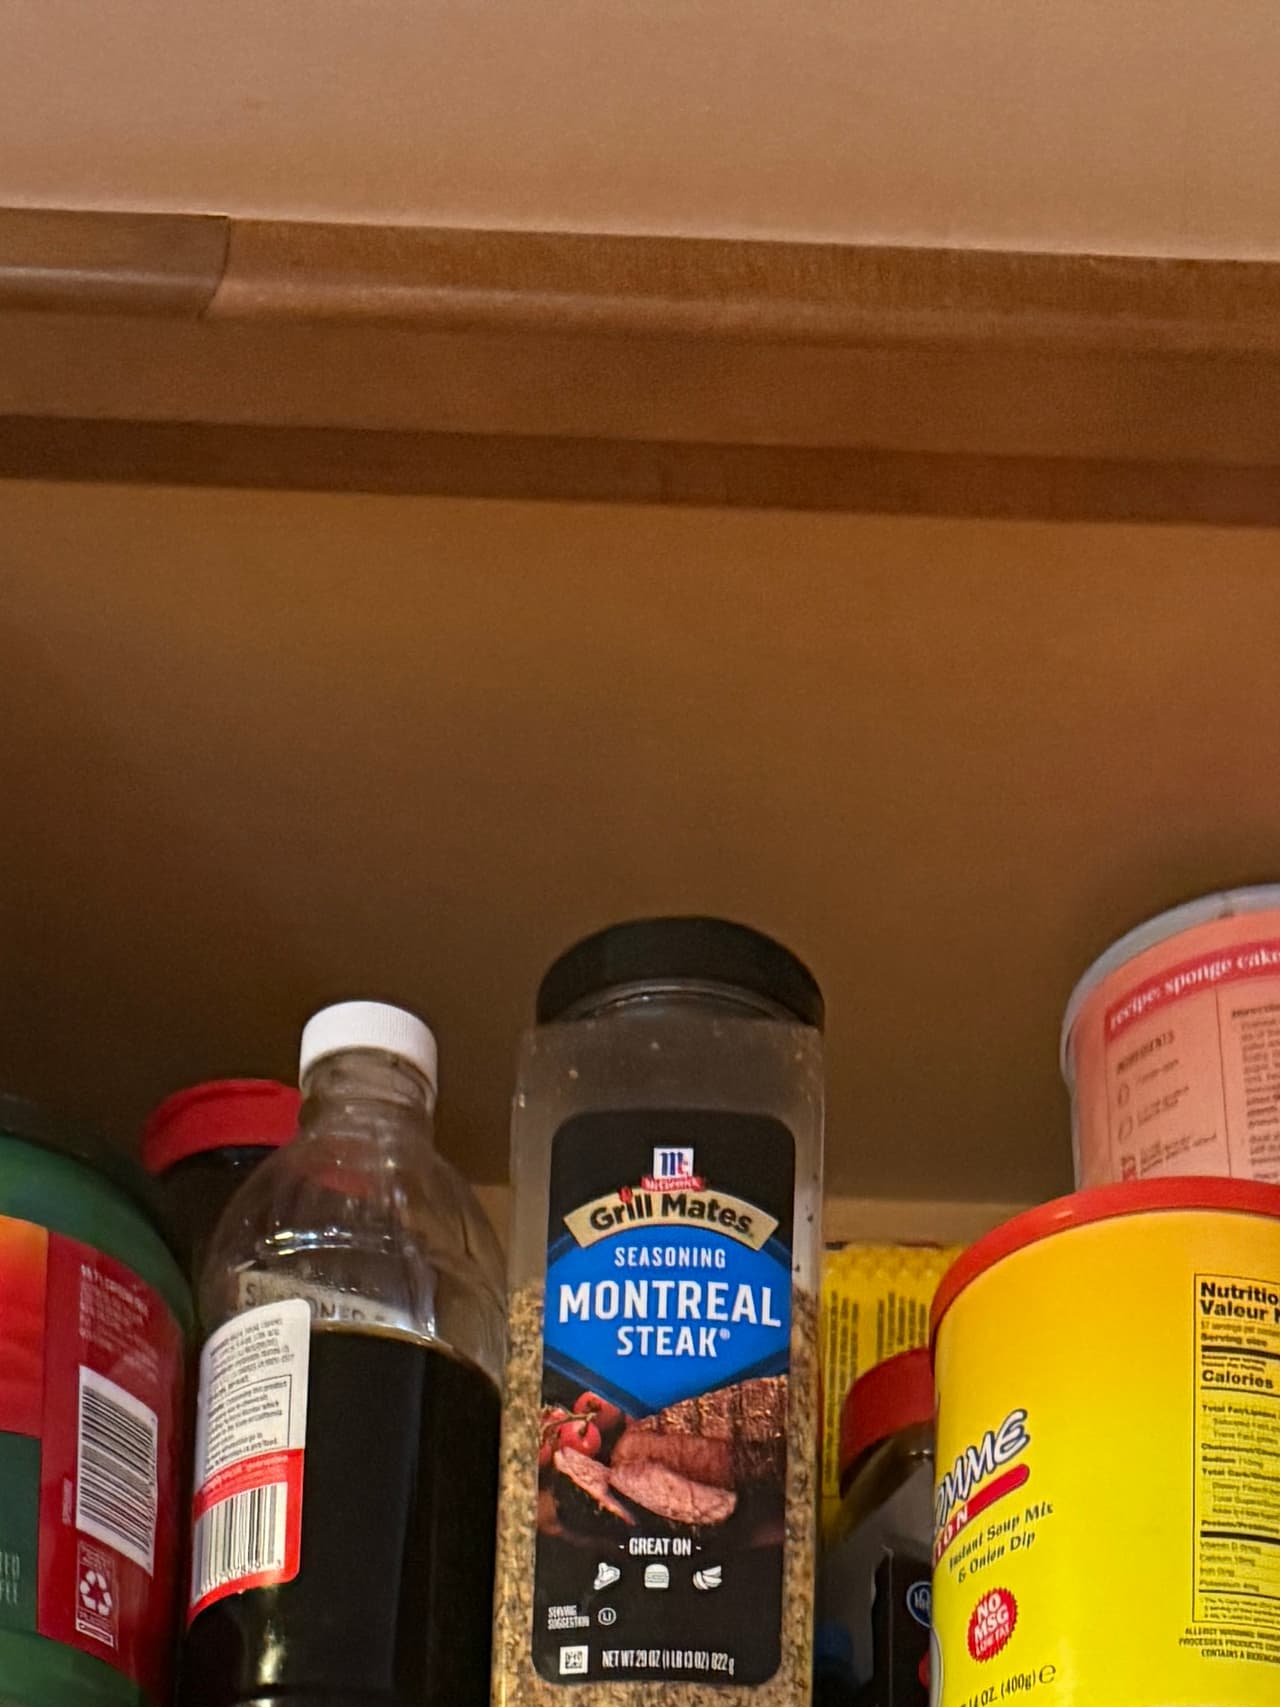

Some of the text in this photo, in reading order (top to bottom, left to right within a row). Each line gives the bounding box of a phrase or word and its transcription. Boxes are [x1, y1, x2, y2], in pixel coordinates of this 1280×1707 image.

[1164, 959, 1231, 994] sponge
[590, 1194, 753, 1234] Grill Mates
[614, 1247, 726, 1268] SEASONING
[559, 1280, 782, 1327] MONTREAL
[1202, 1370, 1273, 1389] Calories
[987, 1516, 1020, 1541] Soup
[629, 1537, 691, 1555] GREAT ON
[970, 1547, 1005, 1575] Onion
[1010, 1531, 1035, 1550] Dip
[978, 1592, 1001, 1617] NO
[974, 1607, 1009, 1640] MSG
